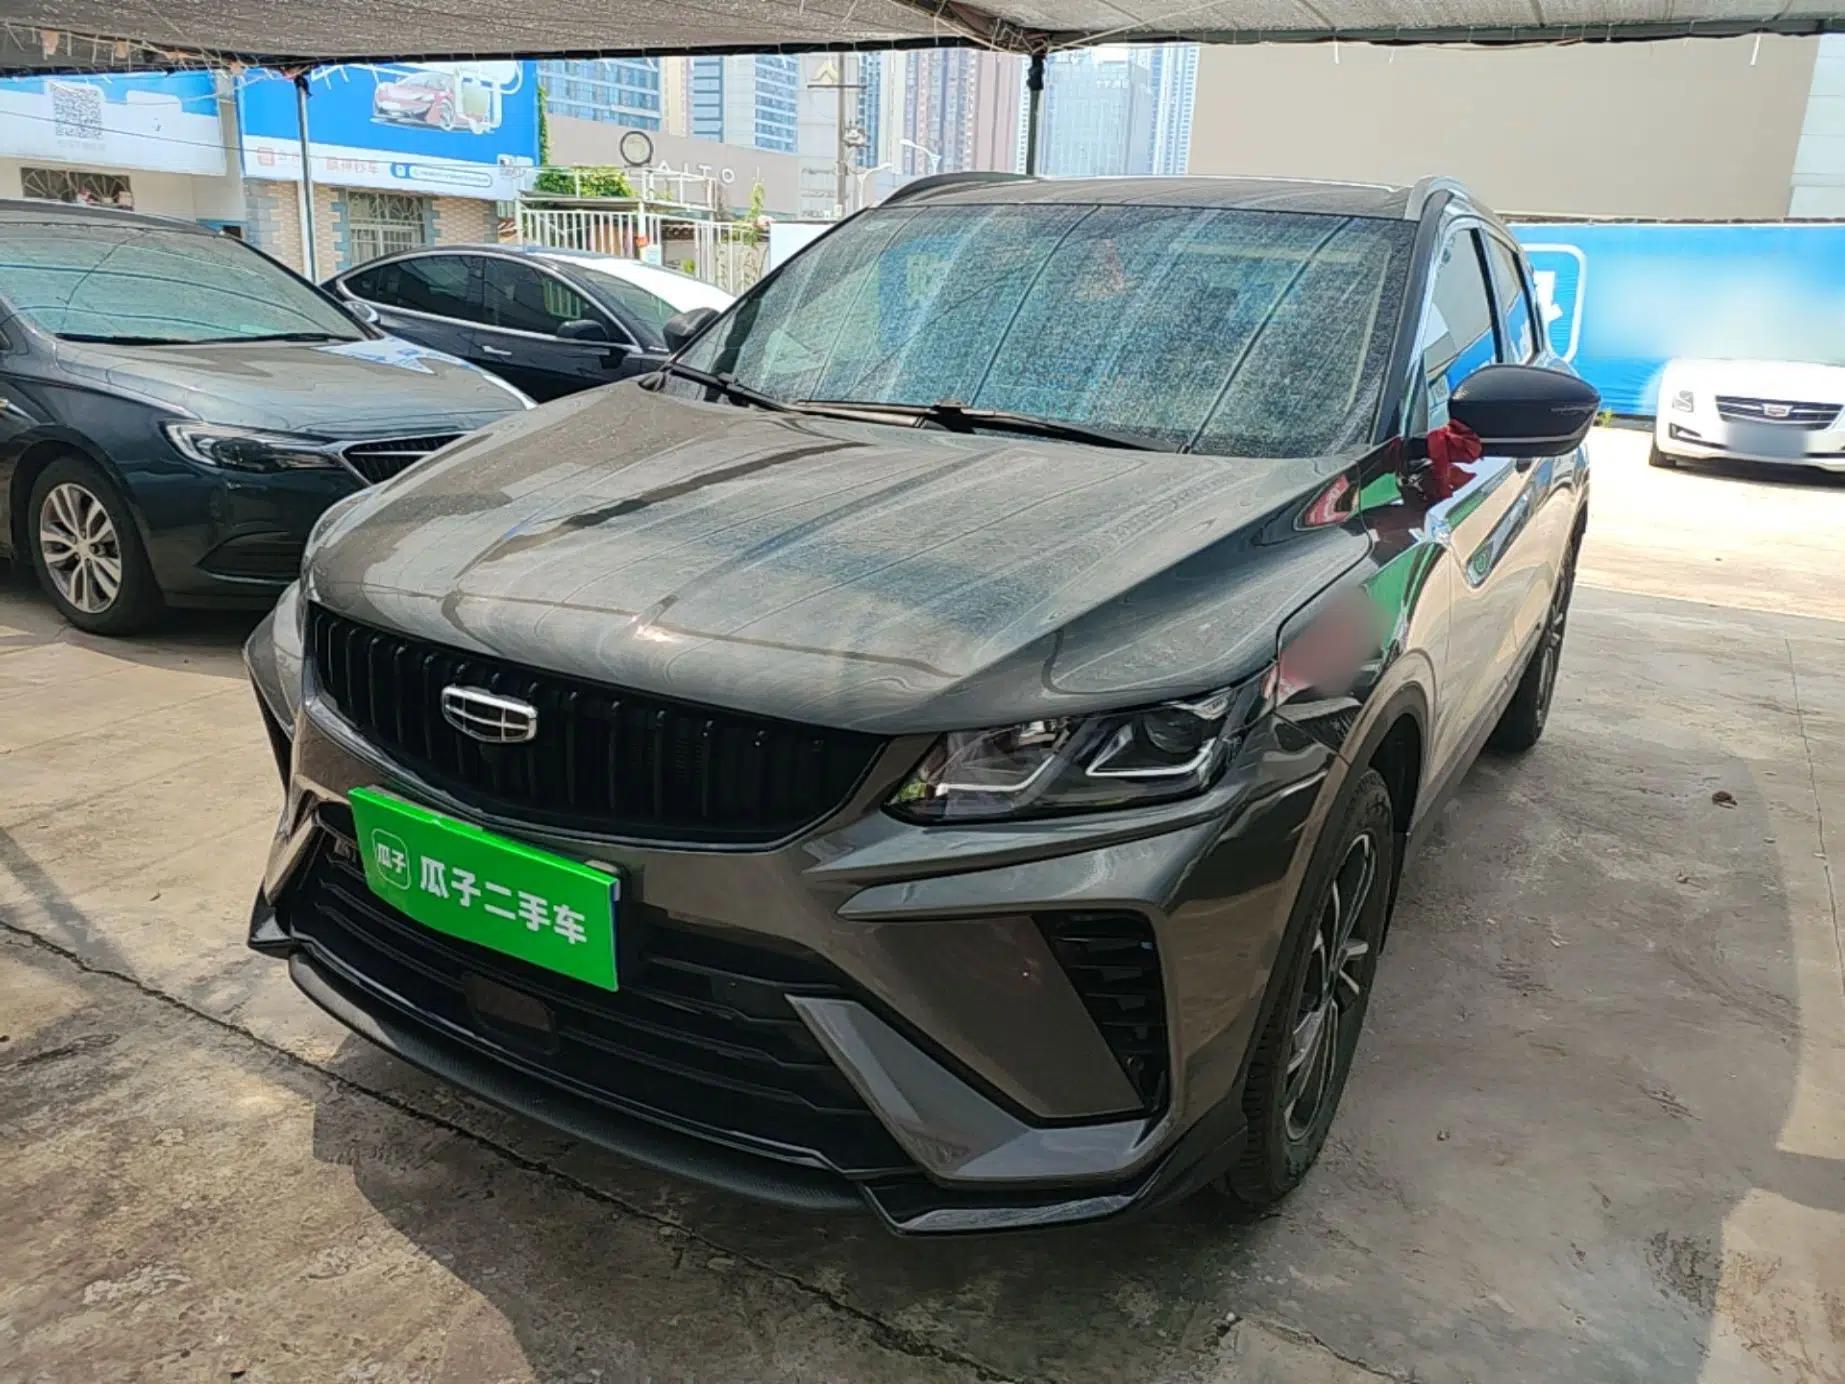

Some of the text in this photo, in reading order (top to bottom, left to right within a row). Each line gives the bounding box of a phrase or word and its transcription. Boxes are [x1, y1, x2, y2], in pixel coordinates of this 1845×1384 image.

[375, 841, 407, 874] 瓜子
[420, 854, 588, 946] 瓜子二手车
